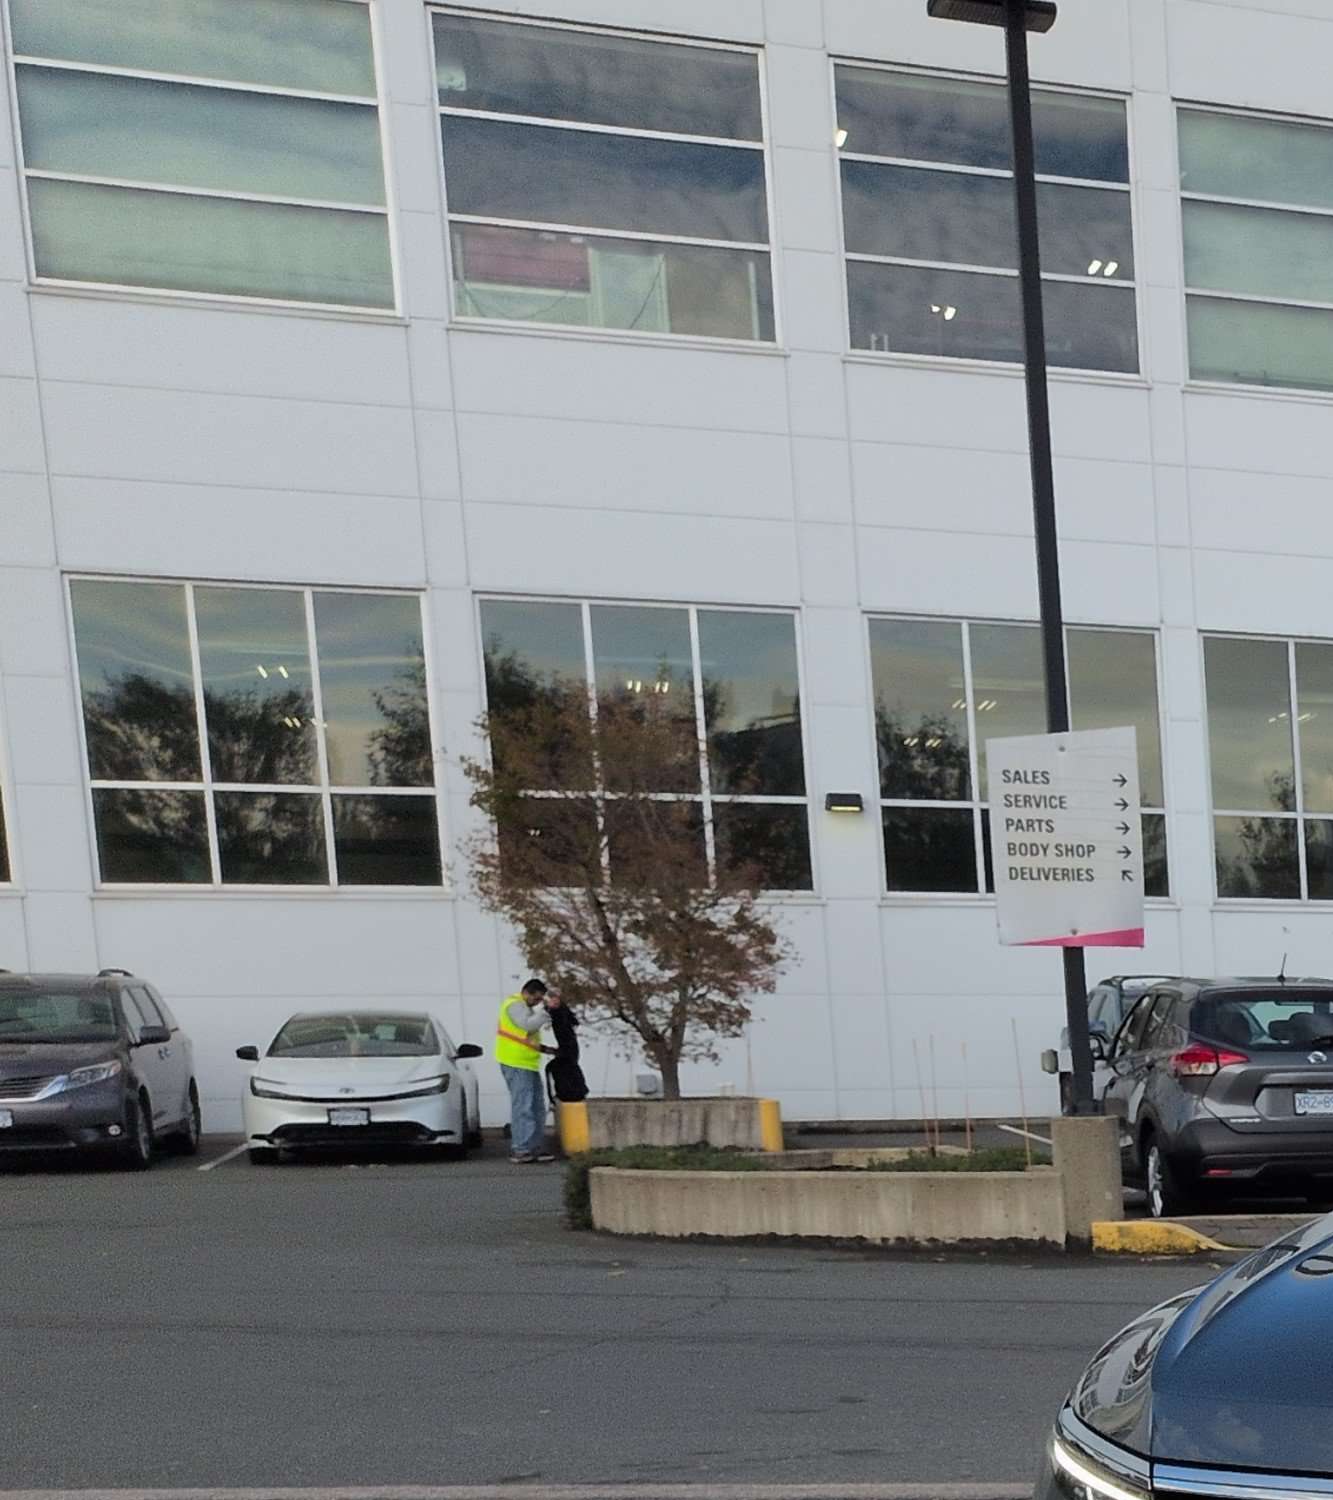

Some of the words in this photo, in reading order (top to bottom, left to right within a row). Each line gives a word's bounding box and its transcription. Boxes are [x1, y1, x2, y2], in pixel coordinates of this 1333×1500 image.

[1001, 769, 1050, 785] SALES
[1003, 794, 1067, 810] SERVICE
[1005, 818, 1055, 834] PARTS
[1007, 842, 1049, 857] BODY
[1055, 843, 1096, 858] SHOP
[1008, 866, 1095, 882] DELIVERIES
